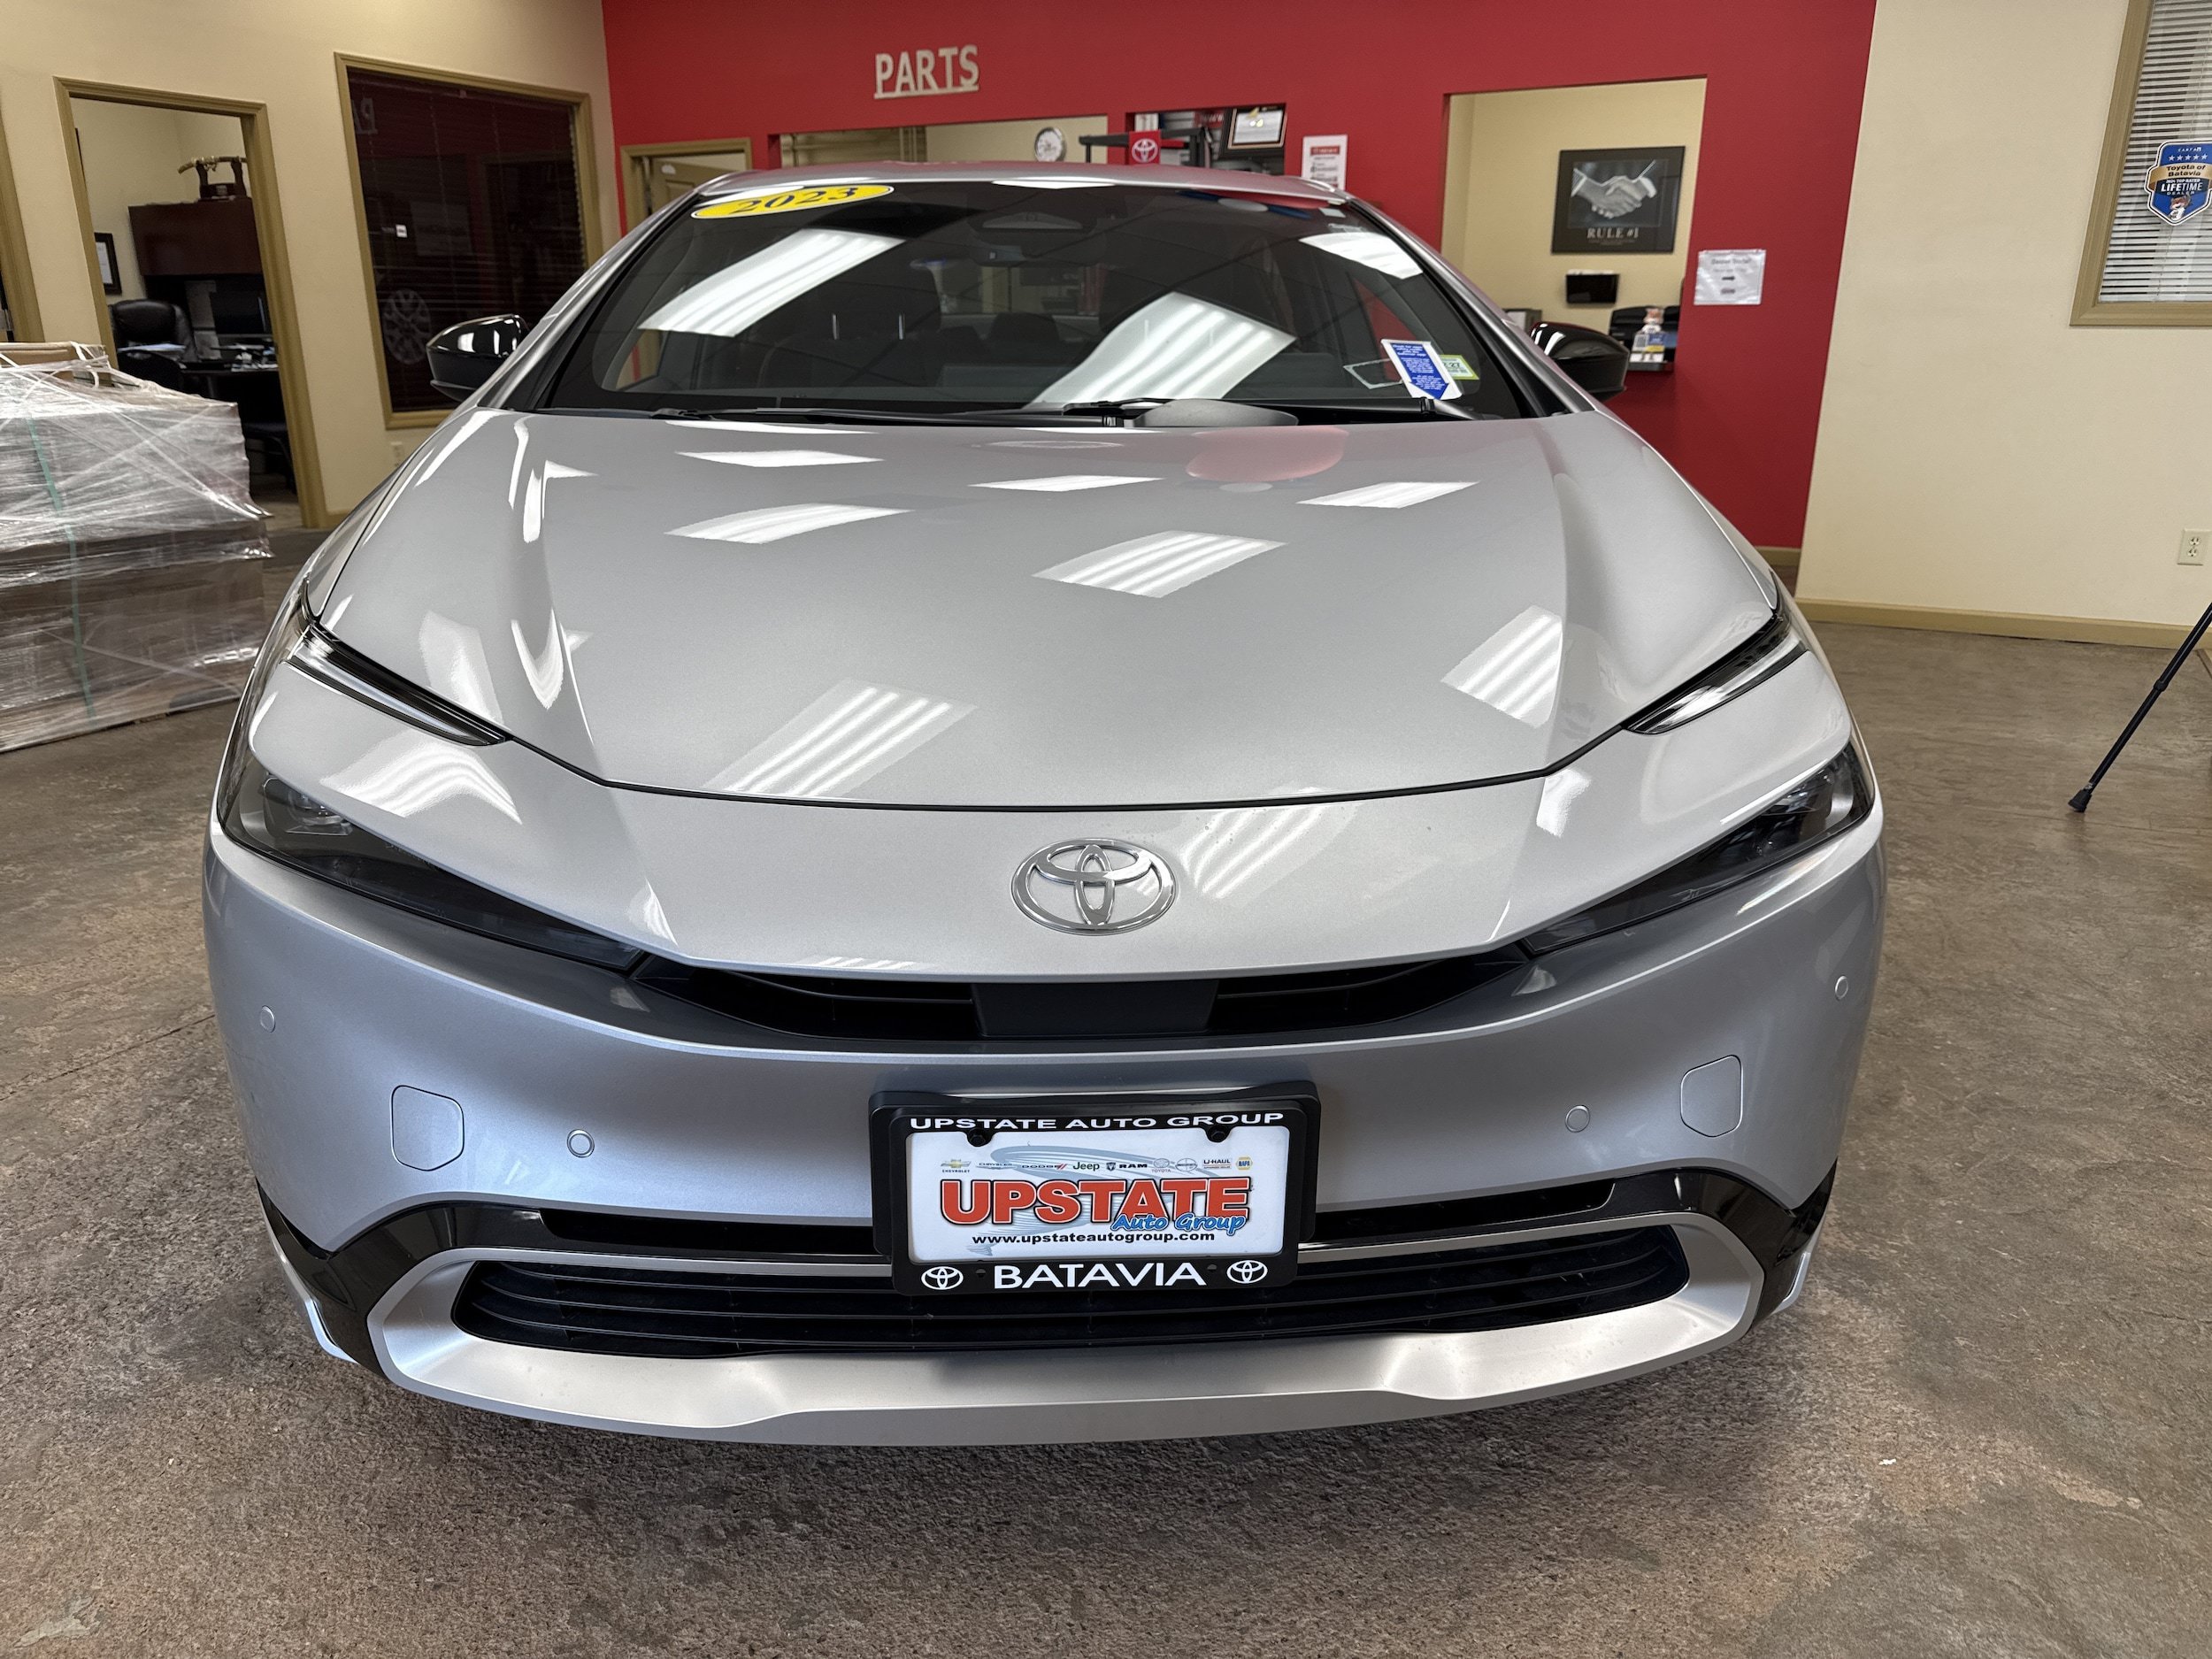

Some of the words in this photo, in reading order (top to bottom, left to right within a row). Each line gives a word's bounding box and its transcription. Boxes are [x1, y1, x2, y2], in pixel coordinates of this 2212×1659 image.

[875, 44, 979, 96] PARTS
[2161, 182, 2203, 192] LIFETIME
[729, 187, 859, 215] 2023
[1586, 227, 1624, 239] RULE
[910, 1118, 1057, 1130] UPSTATE
[1064, 1118, 1157, 1129] AUTO
[1166, 1112, 1285, 1127] GROUP
[1072, 1162, 1100, 1171] Jeep
[941, 1178, 1250, 1225] UPSTATE
[1110, 1213, 1170, 1232] Auto
[1174, 1212, 1247, 1235] Group
[972, 1232, 1215, 1244] www.upstateautogroup.com
[994, 1263, 1207, 1289] BATAVIA
